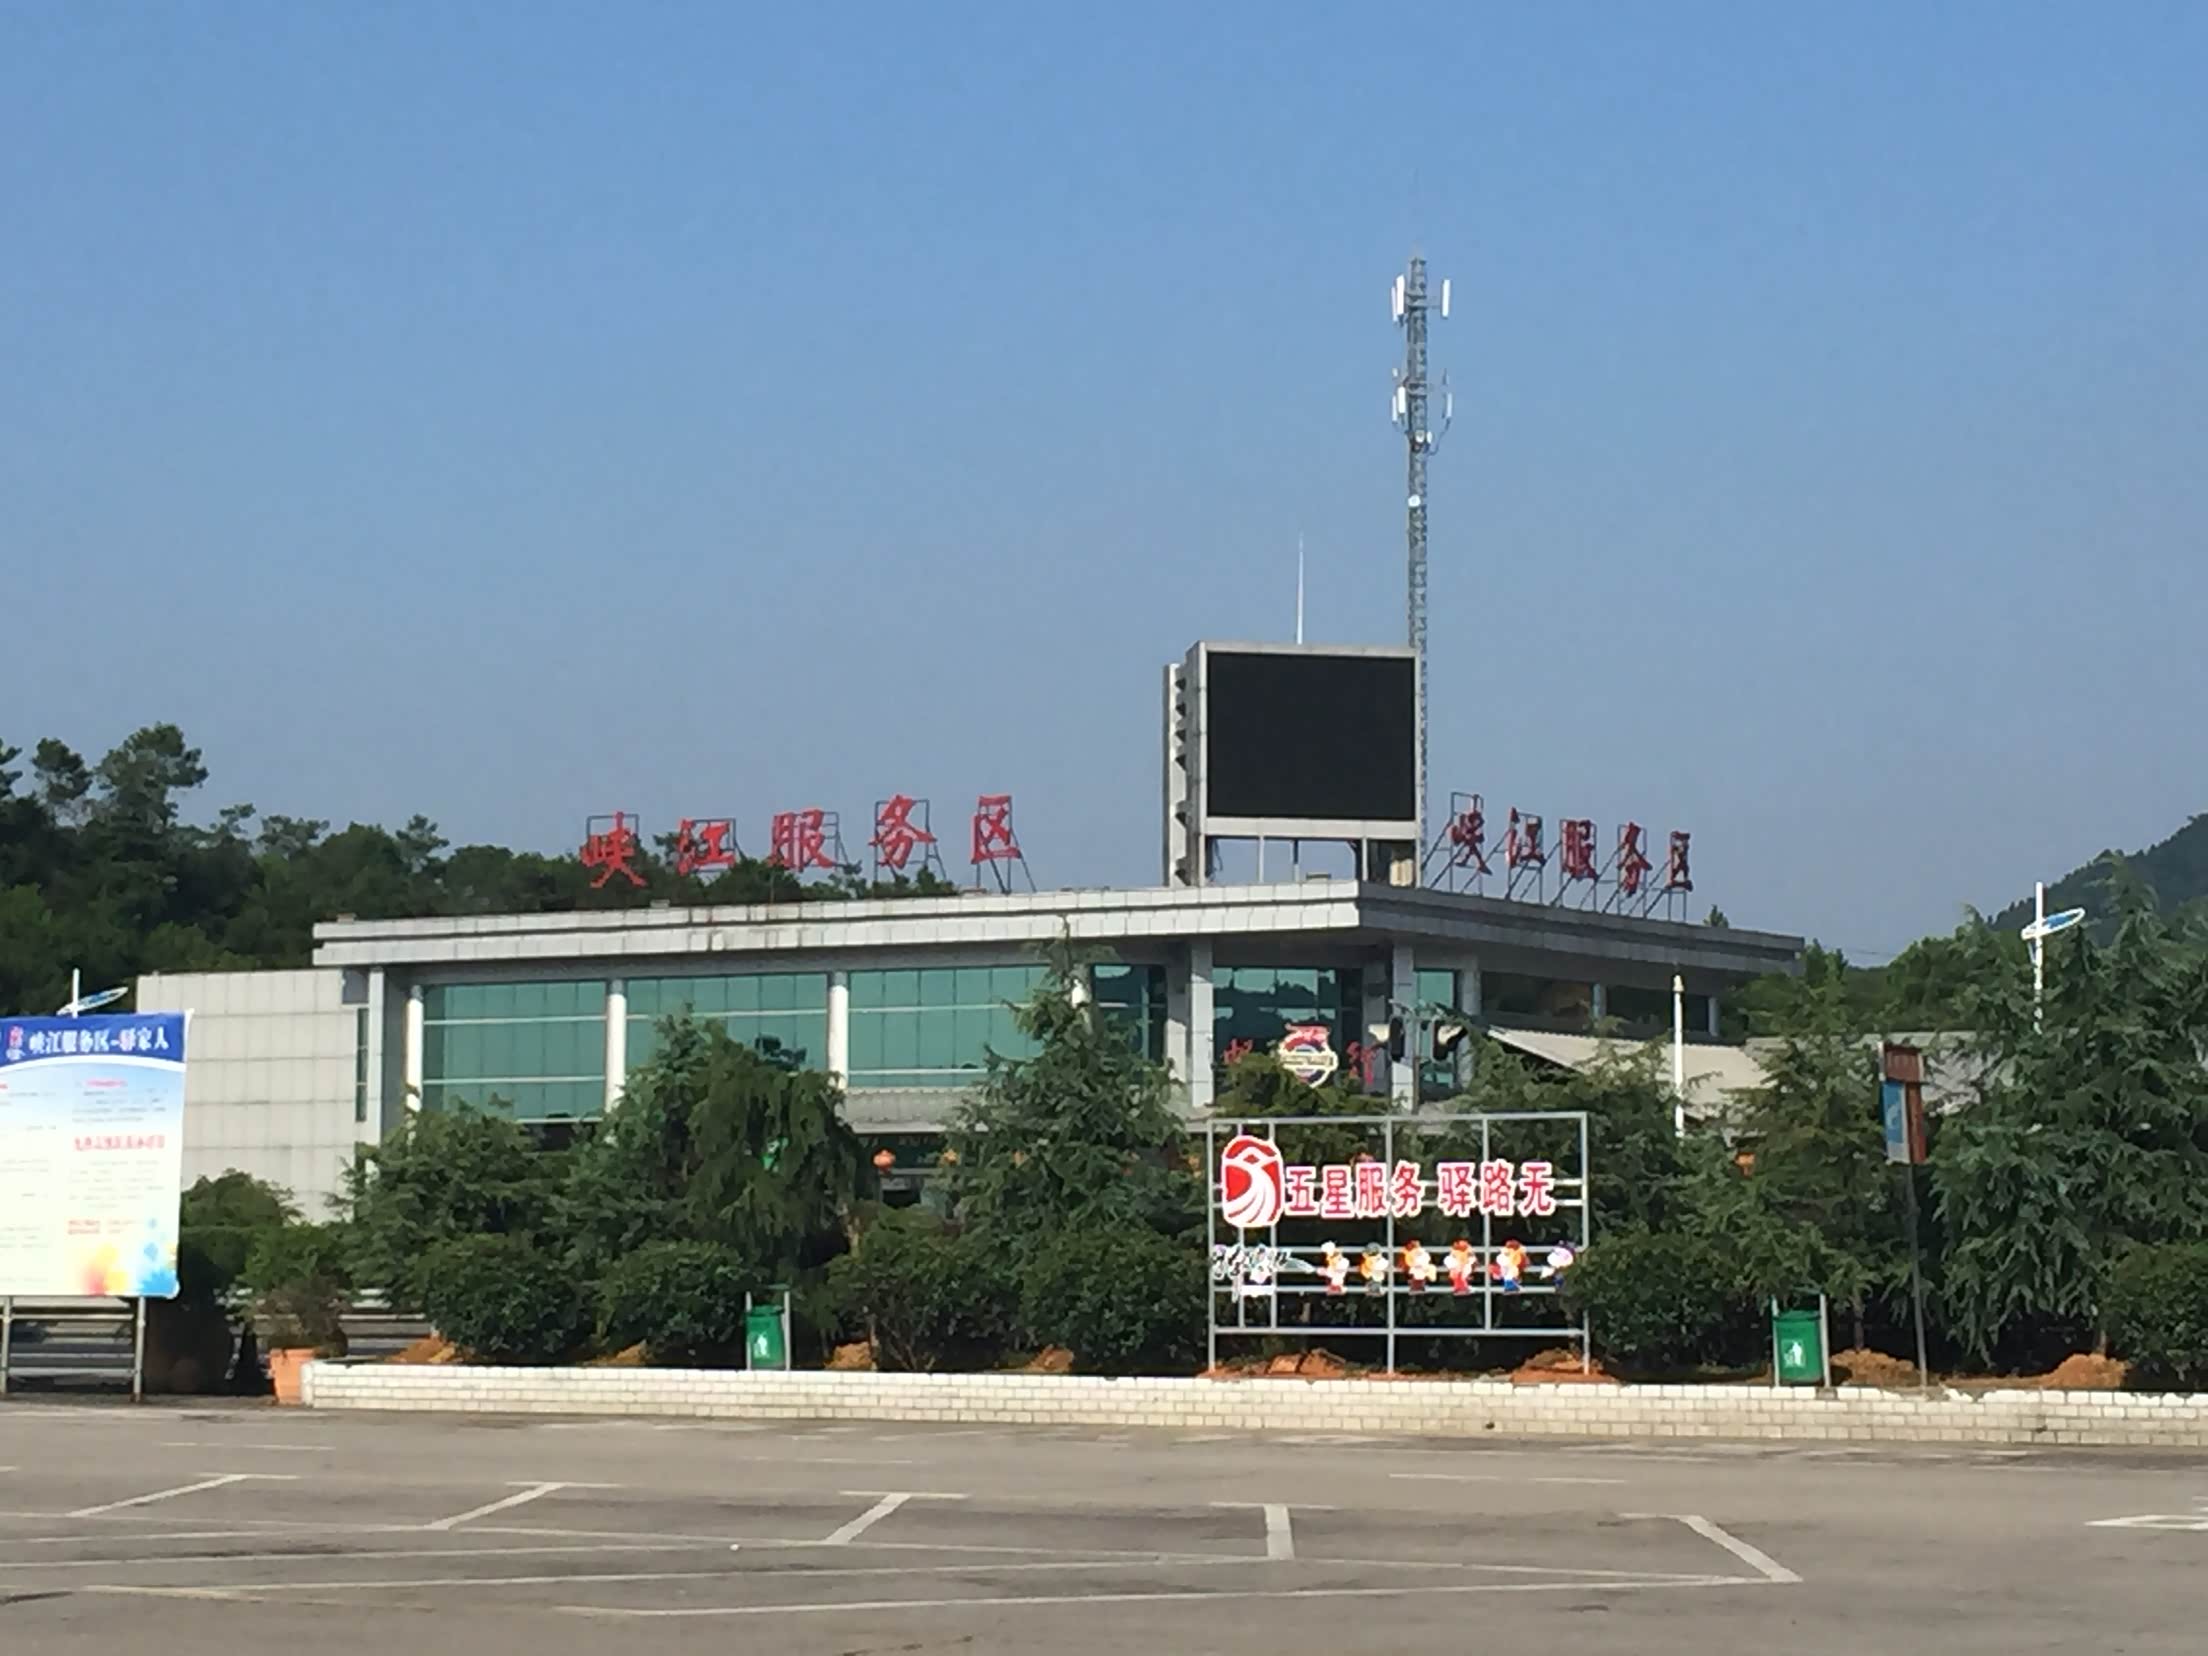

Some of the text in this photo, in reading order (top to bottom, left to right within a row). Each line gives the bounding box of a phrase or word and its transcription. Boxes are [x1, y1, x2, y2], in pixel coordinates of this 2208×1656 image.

[580, 794, 1021, 889] 峡江服务区
[1450, 794, 1693, 897] 峡江服务区
[1286, 1160, 1555, 1218] 五星服务 驿路无
